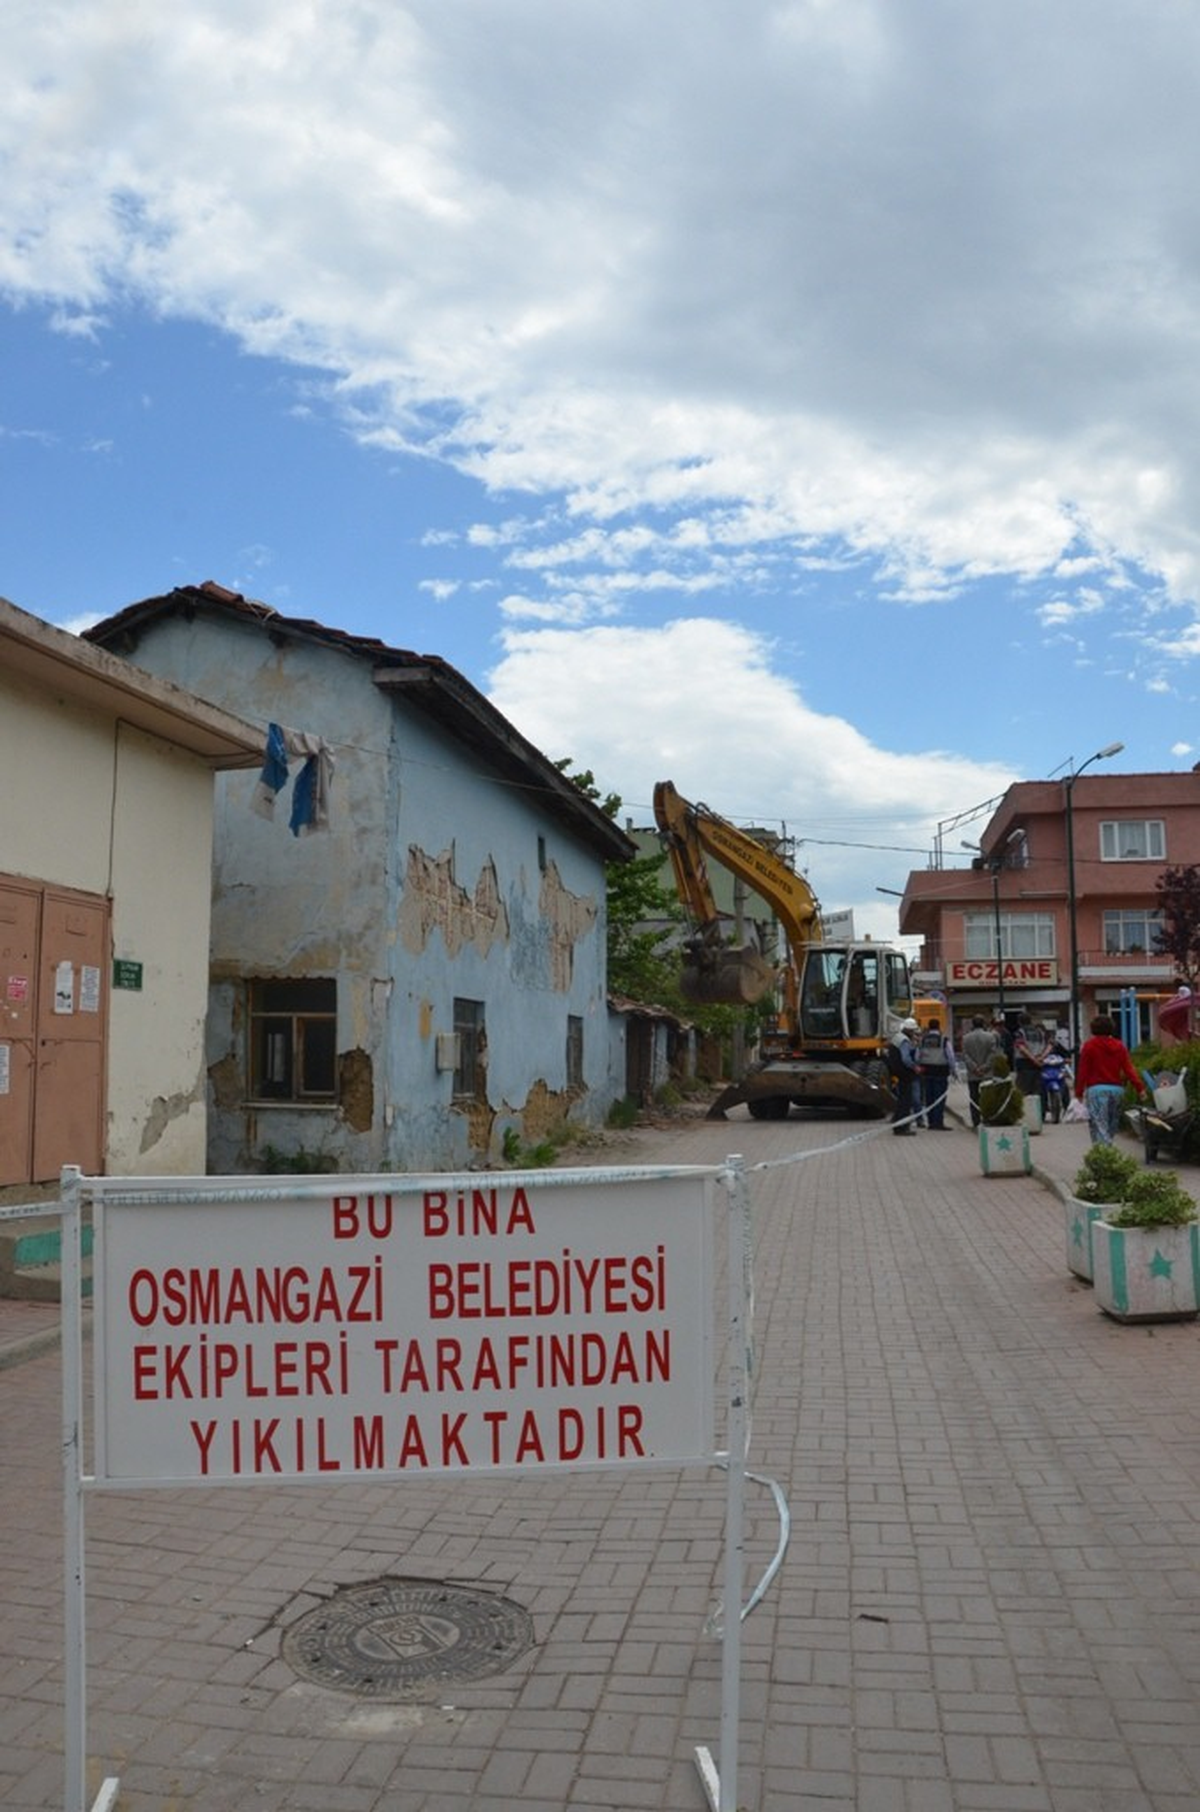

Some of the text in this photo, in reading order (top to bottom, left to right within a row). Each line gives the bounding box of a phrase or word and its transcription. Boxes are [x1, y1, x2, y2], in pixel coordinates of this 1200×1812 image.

[952, 962, 1052, 980] ECZANE
[333, 1195, 393, 1239] BU
[128, 1244, 667, 1327] OSMANGAZİ BELEDİYESİ
[134, 1330, 671, 1400] EKİPLERİ TARAFINDAN
